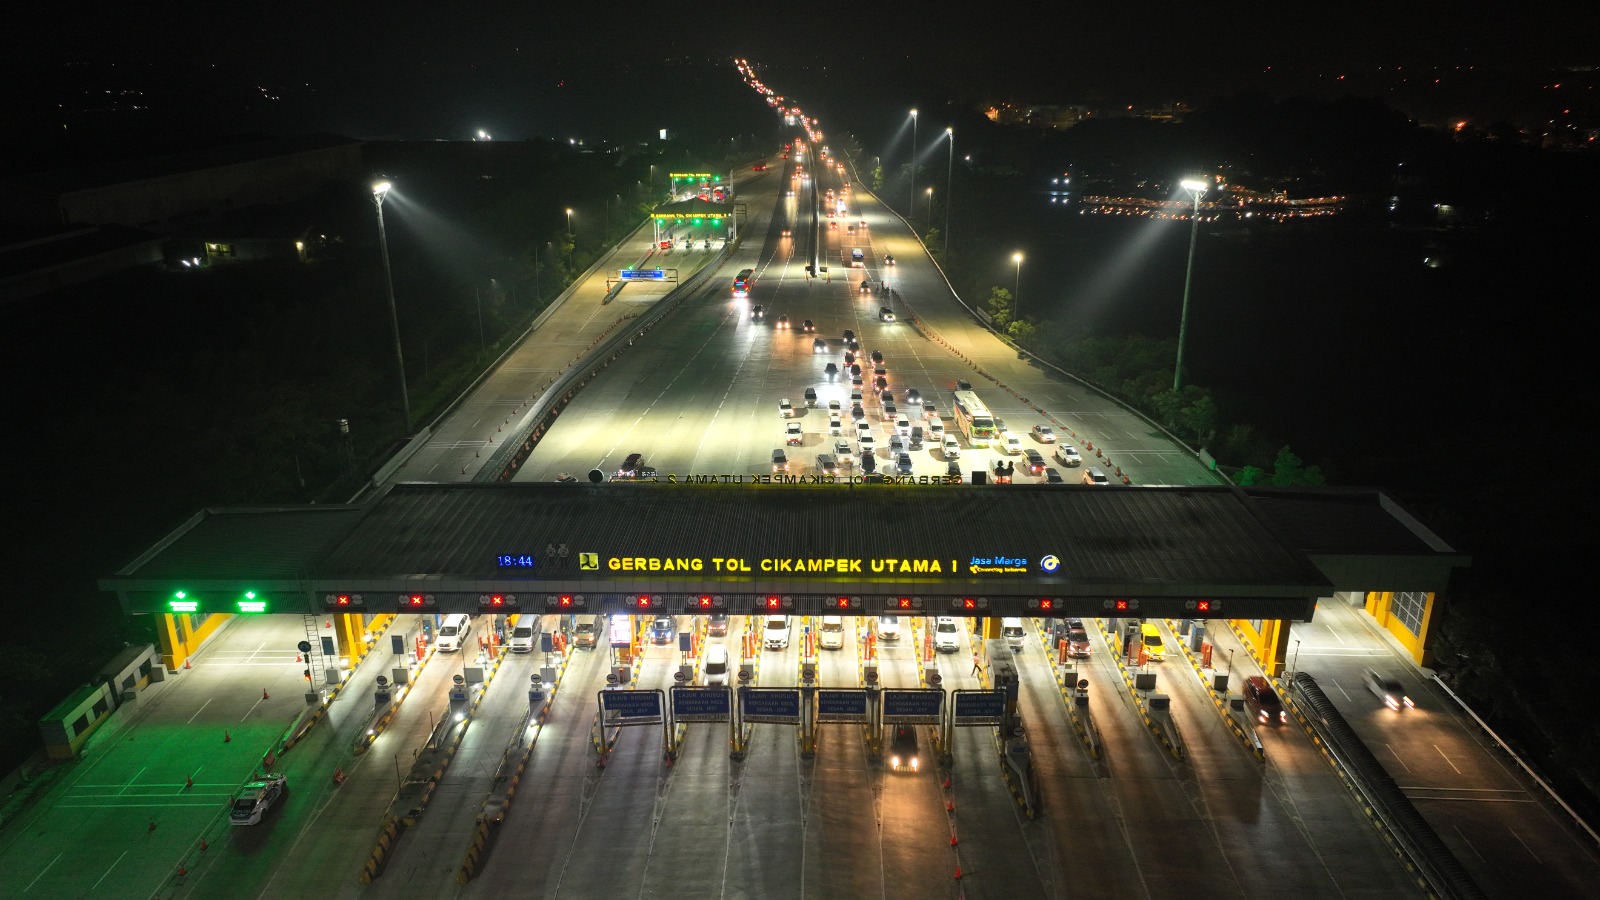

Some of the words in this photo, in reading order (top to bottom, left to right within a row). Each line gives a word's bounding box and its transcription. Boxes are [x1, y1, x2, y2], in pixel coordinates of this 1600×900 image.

[497, 555, 533, 567] 18:44
[608, 557, 703, 571] GERBANG
[712, 558, 752, 571] TOL
[760, 558, 862, 573] CIKAMPEK
[871, 559, 942, 573] UTAMA
[970, 556, 991, 565] Jasa
[994, 556, 1027, 567] Marga
